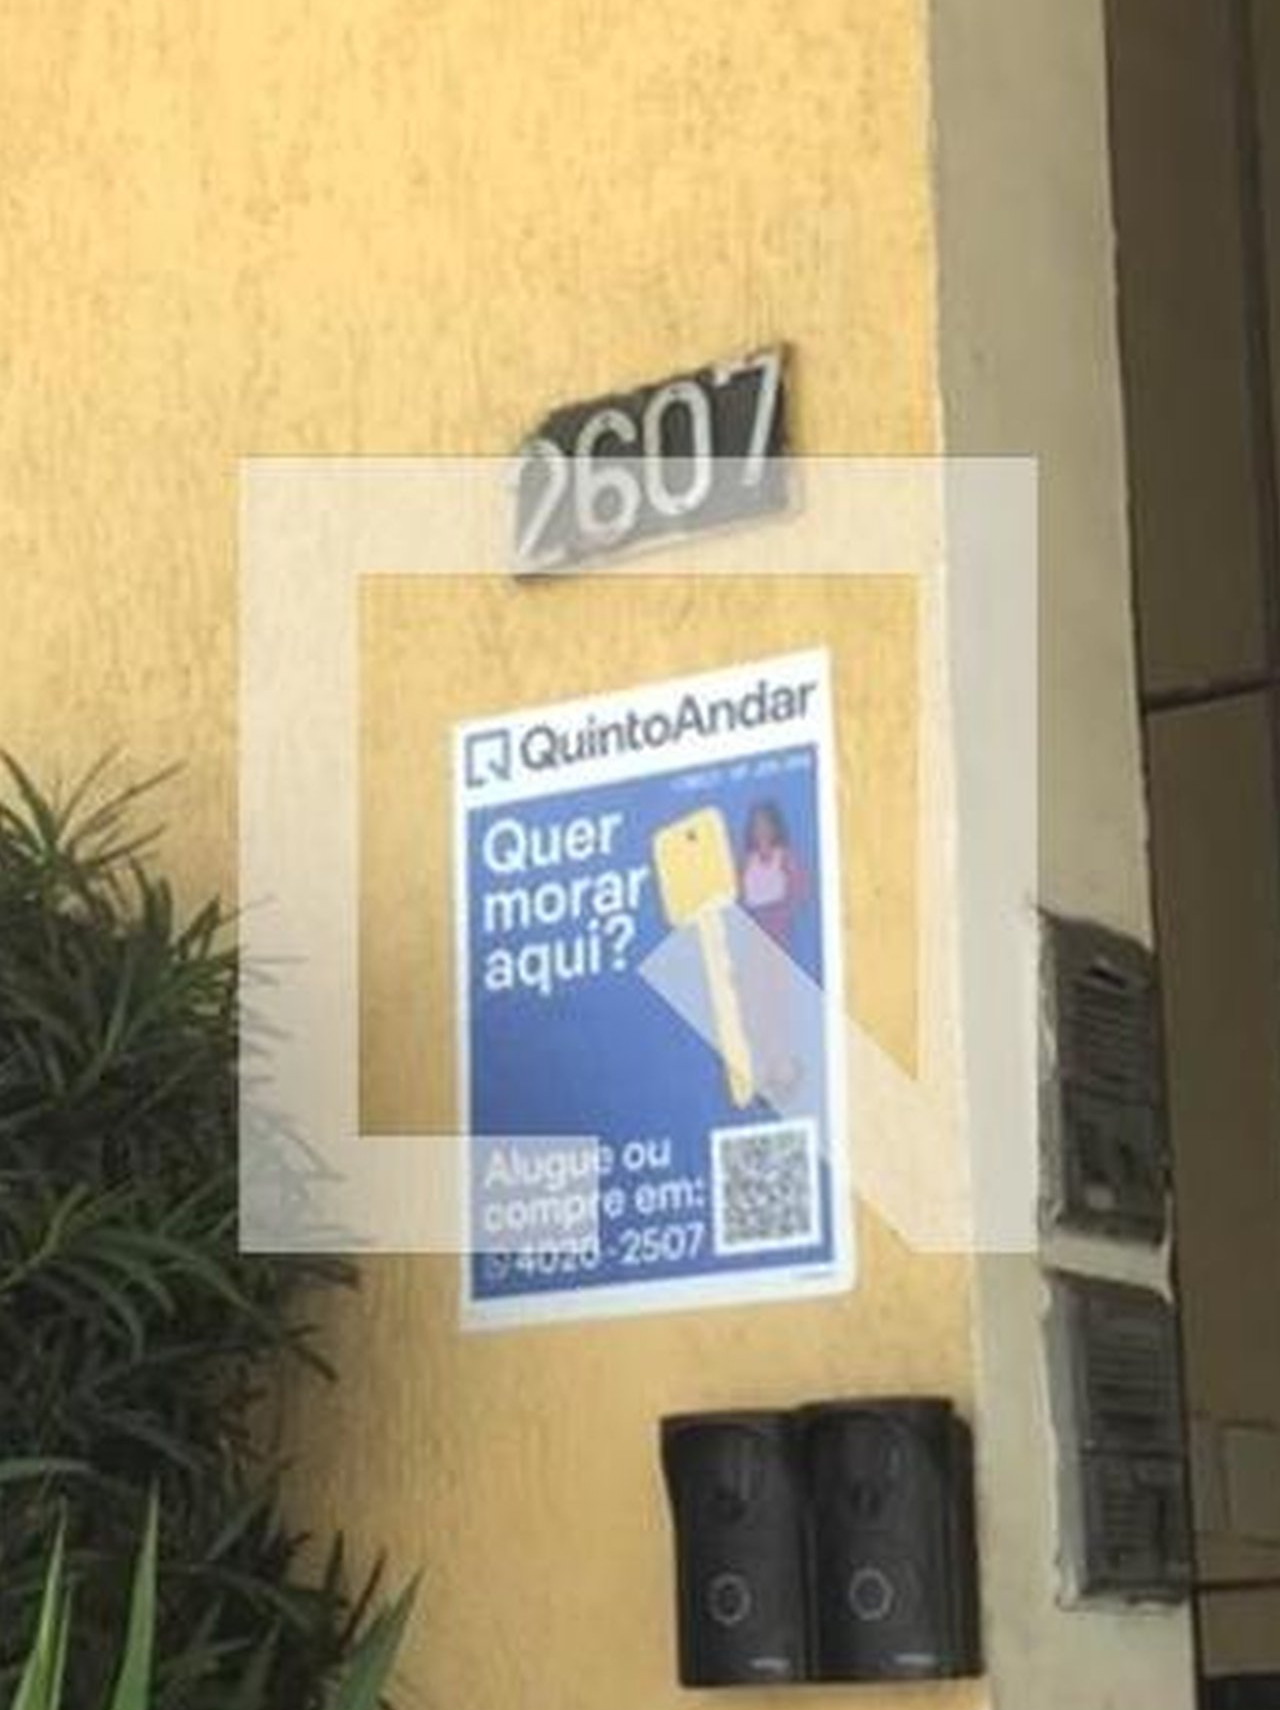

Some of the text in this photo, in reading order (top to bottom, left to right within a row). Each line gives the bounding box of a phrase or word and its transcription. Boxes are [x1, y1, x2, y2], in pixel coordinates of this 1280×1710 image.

[504, 352, 779, 571] 2607
[519, 679, 818, 771] QuintoAndar
[483, 813, 624, 874] Quer
[484, 864, 650, 933] morar
[484, 914, 636, 997] aqui?
[484, 1137, 671, 1192] Alugue ou
[484, 1177, 706, 1234] compre em:
